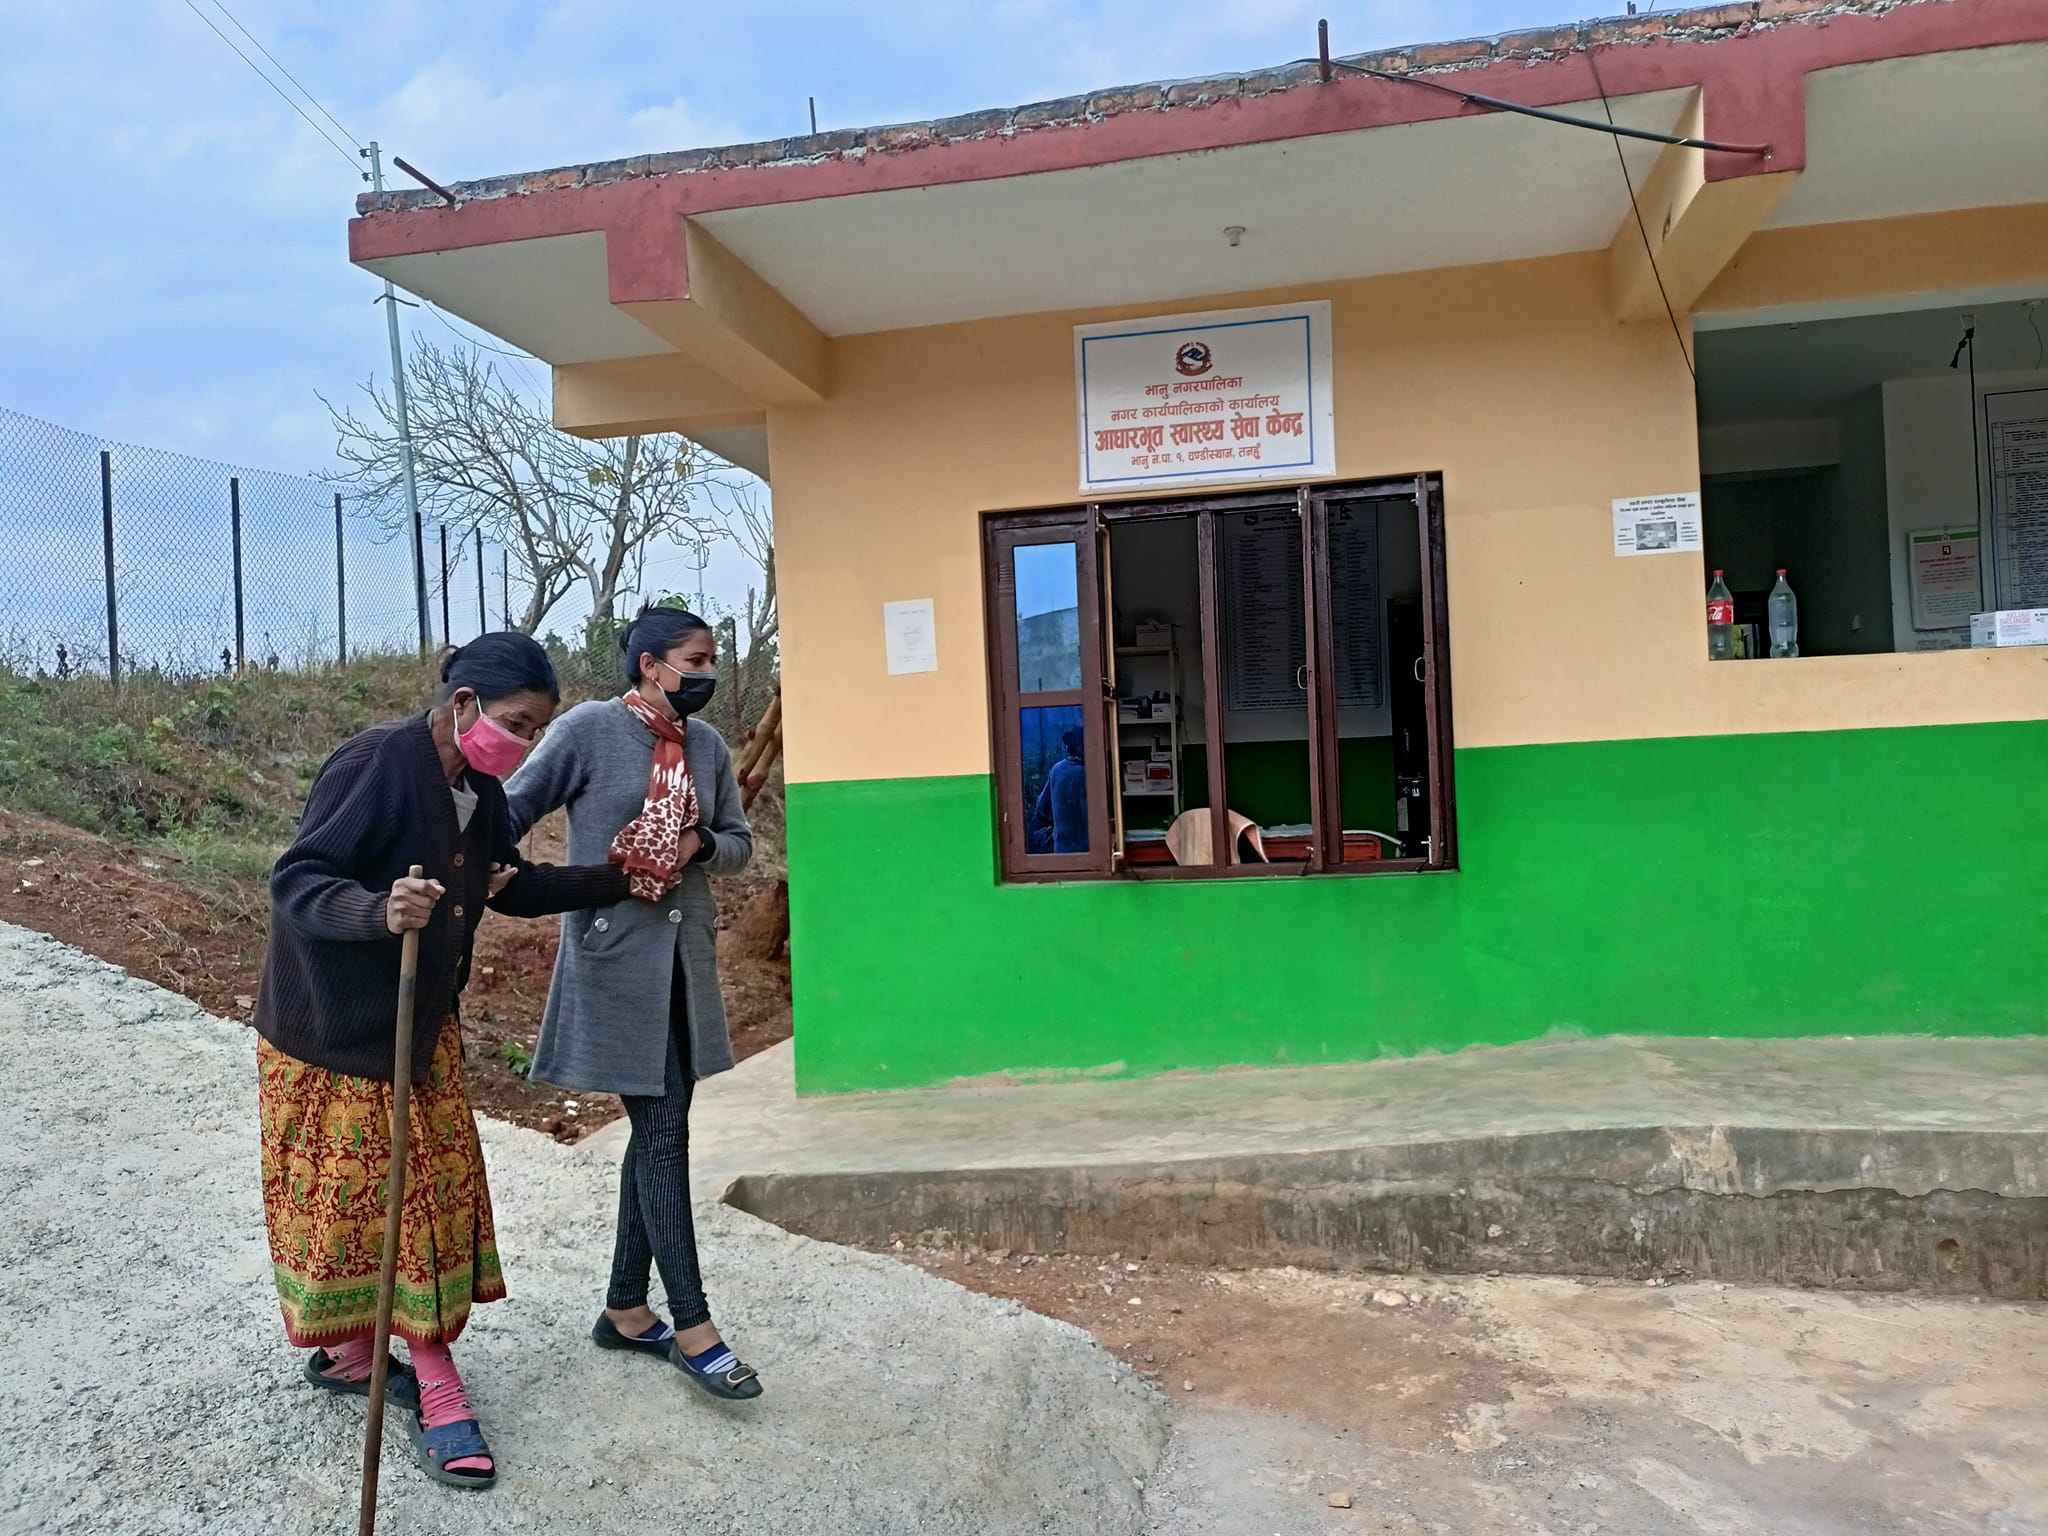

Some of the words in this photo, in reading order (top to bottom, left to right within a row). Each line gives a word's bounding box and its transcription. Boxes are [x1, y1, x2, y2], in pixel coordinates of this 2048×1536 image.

[1145, 384, 1170, 400] भानु
[1172, 375, 1243, 395] नगरपालिका
[1111, 409, 1138, 422] नगर
[1142, 398, 1225, 419] कार्यपालिकाको
[1229, 395, 1280, 411] कार्यालय
[1095, 424, 1165, 453] आधारभूत
[1170, 419, 1225, 446] स्वास्थ्य
[1231, 411, 1261, 440] सेवा
[1265, 408, 1304, 437] केन्द्र
[1131, 456, 1150, 469] भानु
